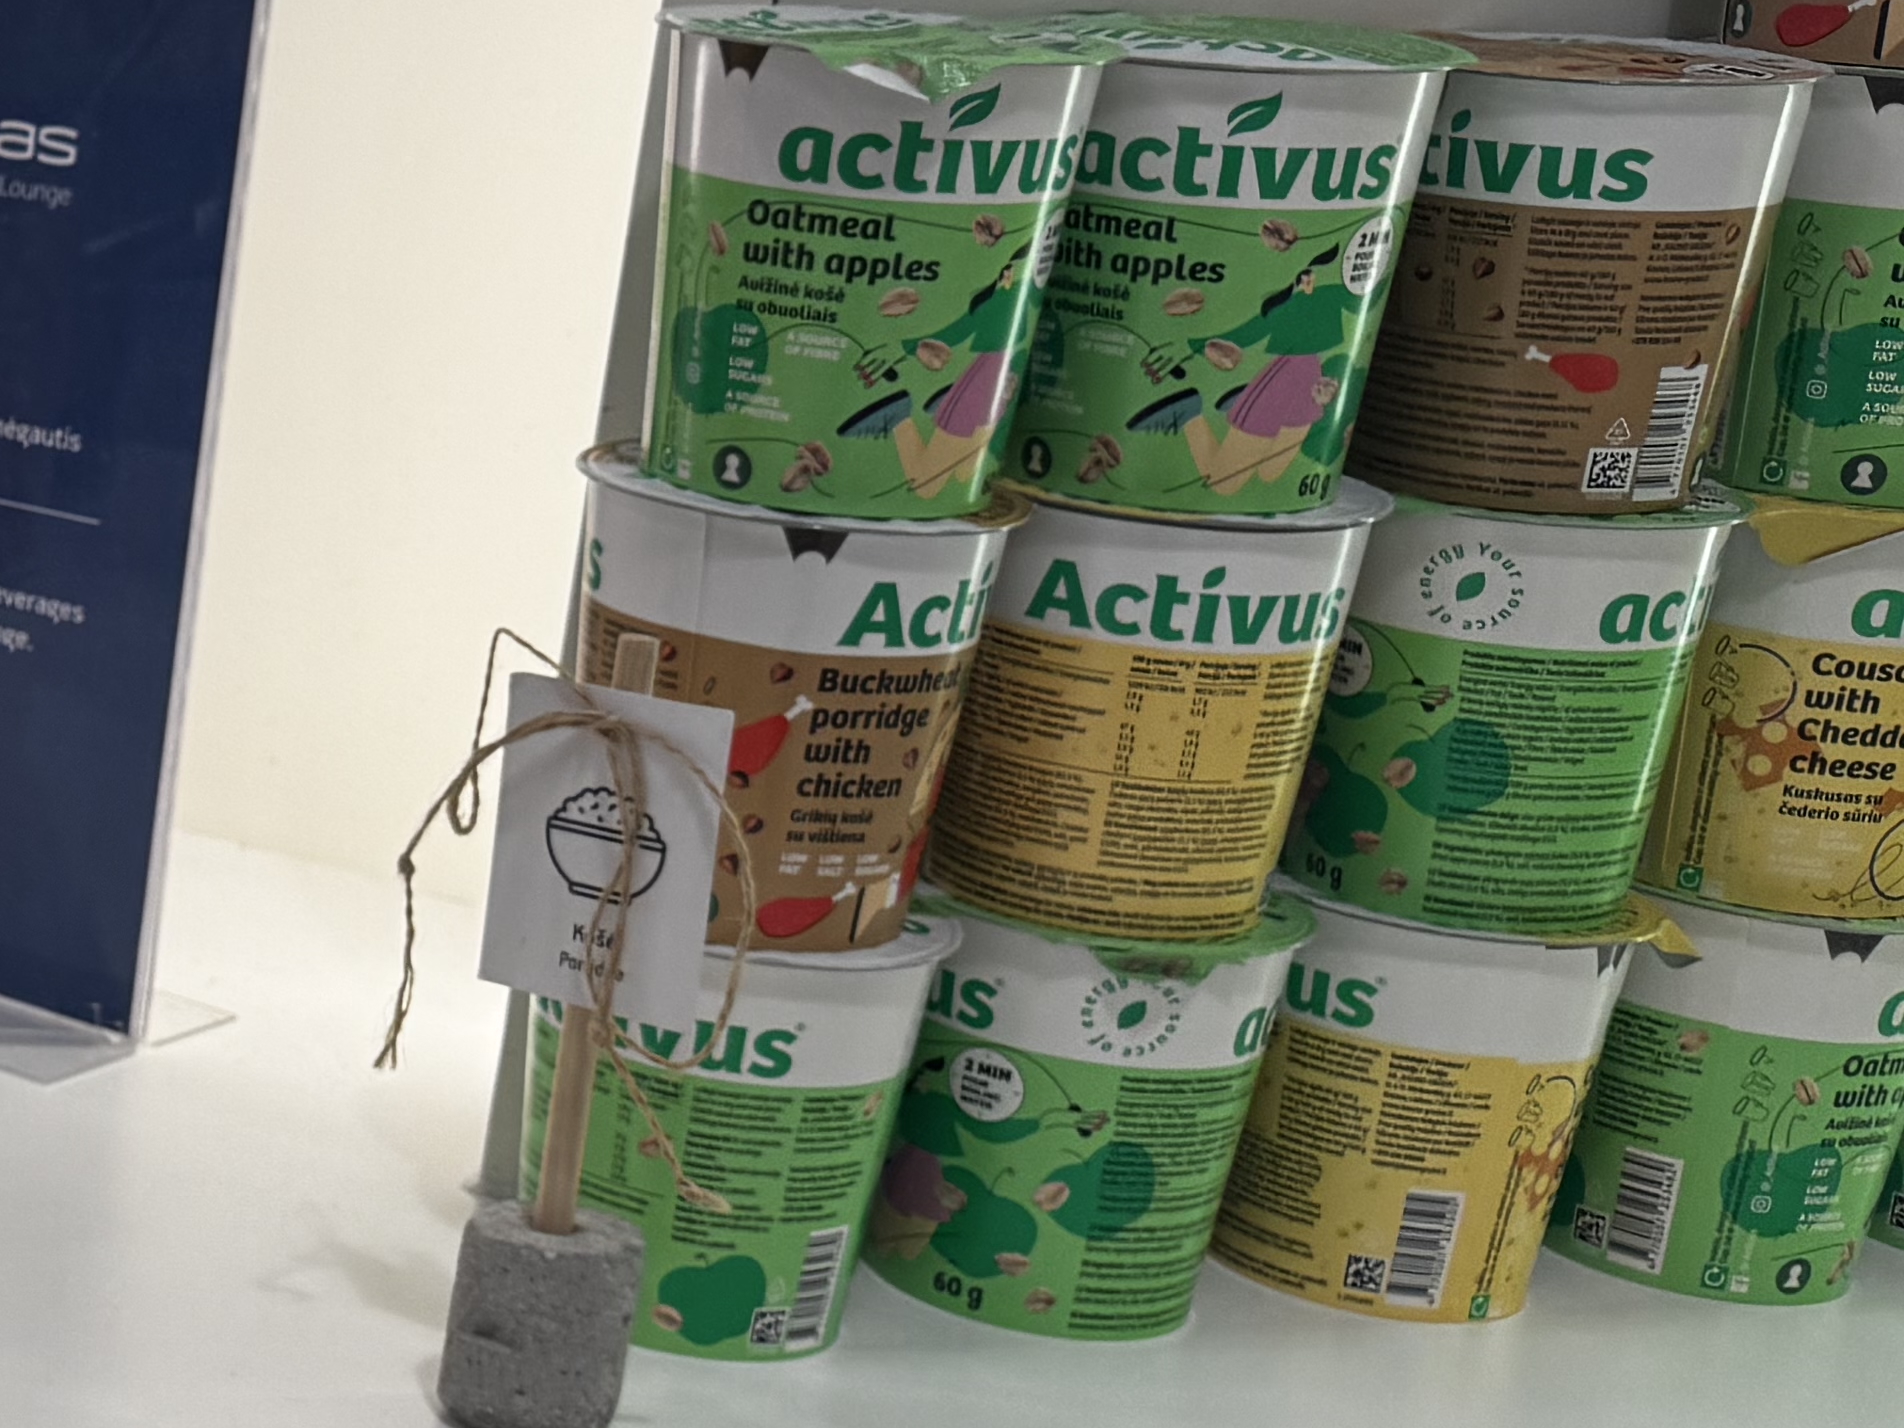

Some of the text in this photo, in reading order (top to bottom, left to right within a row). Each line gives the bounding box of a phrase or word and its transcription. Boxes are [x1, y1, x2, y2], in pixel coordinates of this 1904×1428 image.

[746, 198, 896, 242] Oatmeal
[1064, 207, 1178, 242] atmeal
[742, 239, 941, 286] with apples
[1110, 252, 1226, 285] apples
[757, 300, 838, 324] obuoliais
[1869, 370, 1897, 381] LOW
[1298, 476, 1320, 499] 60
[1419, 541, 1525, 630] Your source of energy
[1024, 559, 1346, 646] Activus
[1804, 686, 1880, 715] with
[809, 706, 928, 733] porridge
[1797, 718, 1904, 749] Chedd
[804, 737, 872, 765] with
[1789, 751, 1897, 781] cheese
[796, 772, 902, 799] chicken
[1782, 783, 1884, 806] Kuskusas su
[1778, 800, 1840, 822] čederio
[977, 1061, 1012, 1084] MIN
[1833, 1083, 1889, 1108] with
[933, 1271, 984, 1312] 60 g
